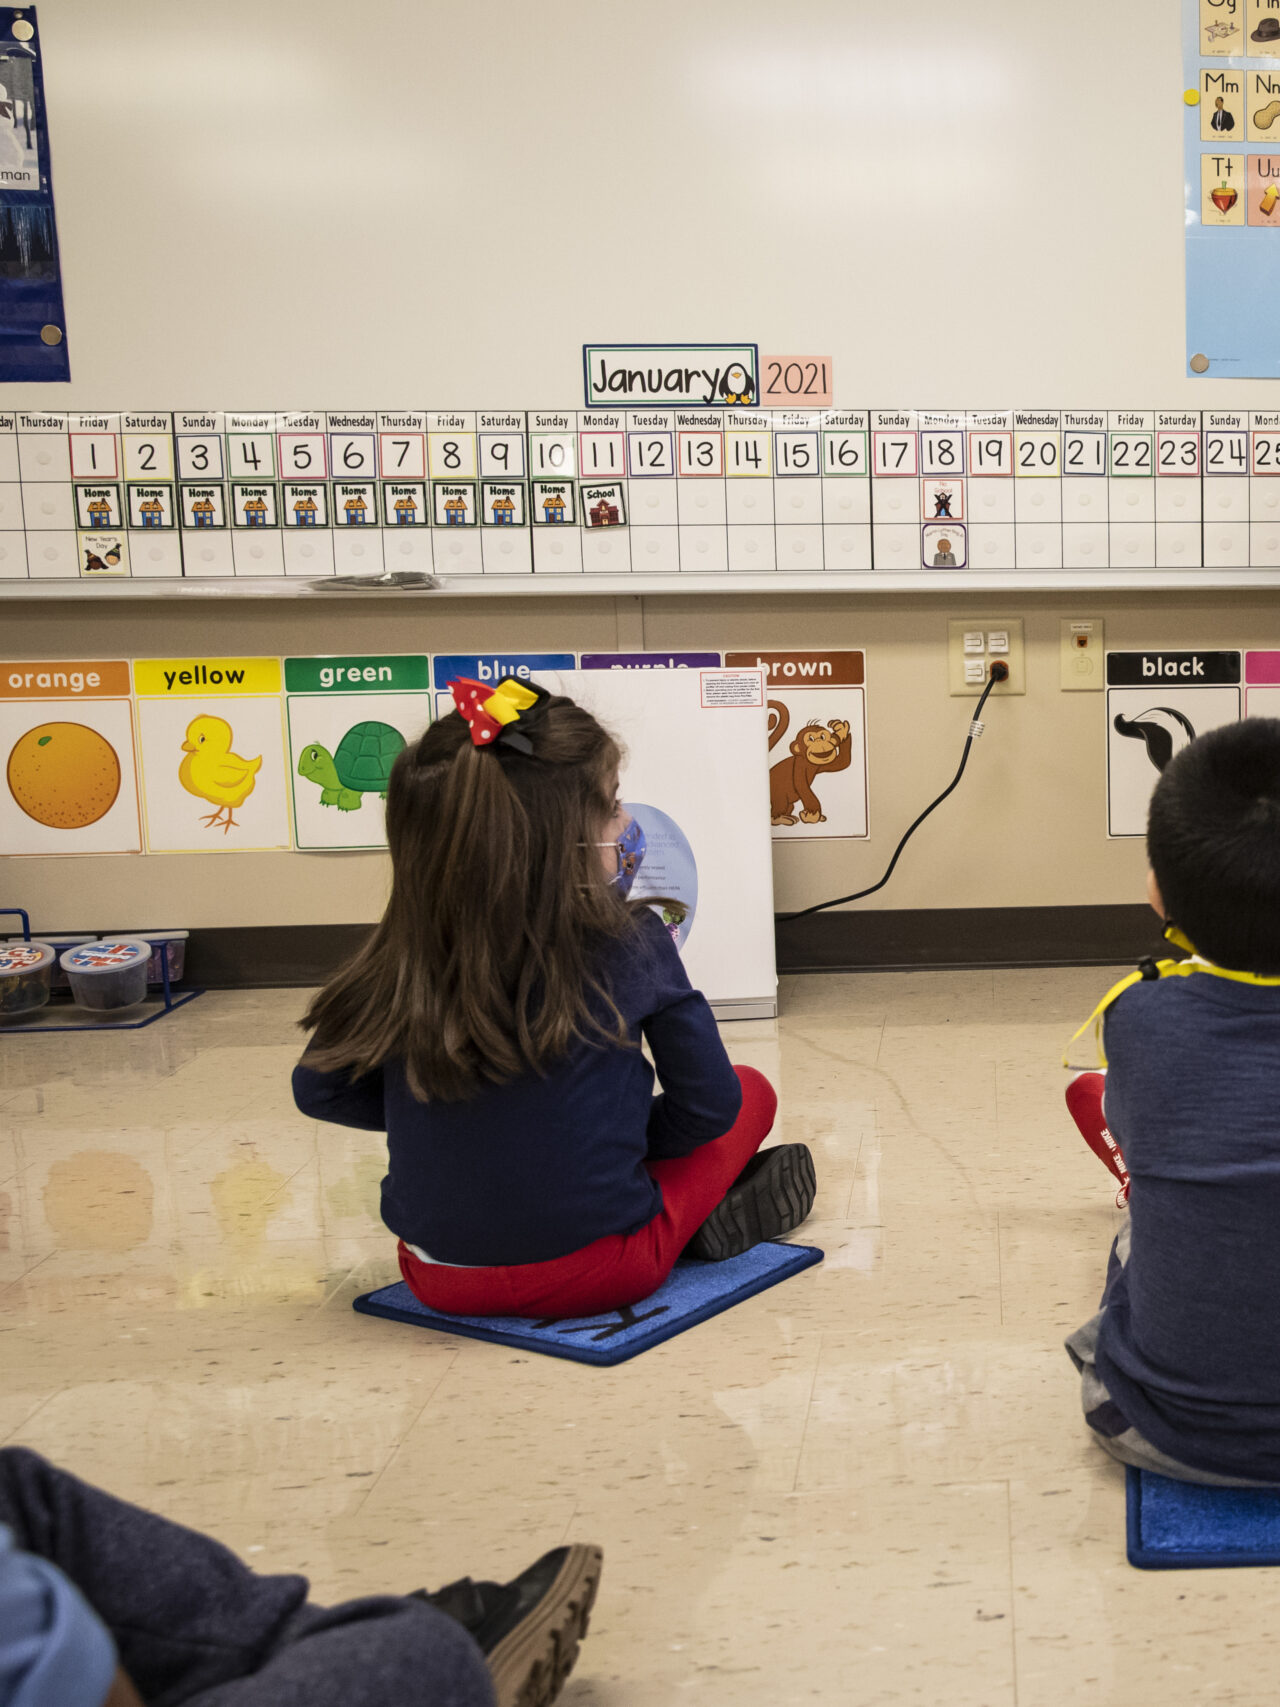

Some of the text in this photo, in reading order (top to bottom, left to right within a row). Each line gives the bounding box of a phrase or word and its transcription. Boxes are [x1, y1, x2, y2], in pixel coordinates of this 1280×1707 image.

[1205, 73, 1239, 94] Mm
[1256, 74, 1280, 94] Nn
[1211, 157, 1234, 177] Tt
[1258, 158, 1280, 178] Uu
[592, 358, 721, 404] January
[766, 362, 828, 395] 2021
[20, 416, 64, 430] Thursday
[79, 416, 109, 430] Friday
[125, 416, 168, 430] Saturday
[182, 416, 216, 430] Sunday
[231, 416, 269, 429] Monday
[282, 416, 320, 430] Tuesday
[329, 416, 375, 430] Wednesday
[381, 416, 422, 430] Thursday
[437, 415, 465, 429] Friday
[481, 416, 521, 428] Saturday
[536, 416, 568, 428] Sunday
[583, 416, 620, 428] Monday
[632, 416, 668, 428] Tuesday
[677, 415, 722, 428] Wednesday
[728, 415, 768, 428] Thursday
[825, 415, 864, 428] Saturday
[878, 415, 910, 428] Sunday
[972, 414, 1007, 427] Tuesday
[1016, 414, 1059, 428] Wednesday
[1064, 414, 1104, 428] Thursday
[1118, 414, 1144, 428] Friday
[1158, 415, 1197, 428] Saturday
[1210, 415, 1241, 428] Sunday
[138, 443, 157, 471] 2
[190, 444, 210, 471] 3
[242, 441, 262, 471] 4
[293, 444, 312, 469] 5
[343, 442, 364, 469] 6
[392, 441, 410, 468] 7
[442, 441, 462, 468] 8
[490, 443, 509, 470] 9
[540, 443, 566, 468] 10
[592, 442, 614, 468] 11
[638, 441, 666, 467] 12
[687, 440, 714, 466] 13
[735, 440, 762, 468] 14
[784, 442, 810, 468] 15
[830, 440, 858, 466] 16
[882, 442, 908, 468] 17
[928, 439, 955, 466] 18
[978, 440, 1003, 466] 19
[1019, 441, 1057, 467] 20
[1068, 440, 1101, 466] 21
[1114, 441, 1150, 466] 22
[1160, 440, 1198, 466] 23
[1208, 438, 1246, 466] 24
[85, 488, 112, 498] Home
[136, 488, 164, 498] Home
[188, 488, 215, 498] Home
[240, 487, 268, 498] Home
[291, 487, 318, 498] Home
[341, 486, 367, 496] Home
[391, 486, 417, 496] Home
[442, 486, 468, 496] Home
[490, 486, 516, 496] Home
[540, 484, 566, 494] Home
[586, 488, 615, 499] School
[96, 542, 108, 550] Day
[478, 660, 530, 680] blue
[756, 657, 833, 678] brown
[1142, 656, 1205, 676] black
[8, 669, 101, 693] orange
[163, 665, 246, 690] yellow
[319, 665, 393, 688] green
